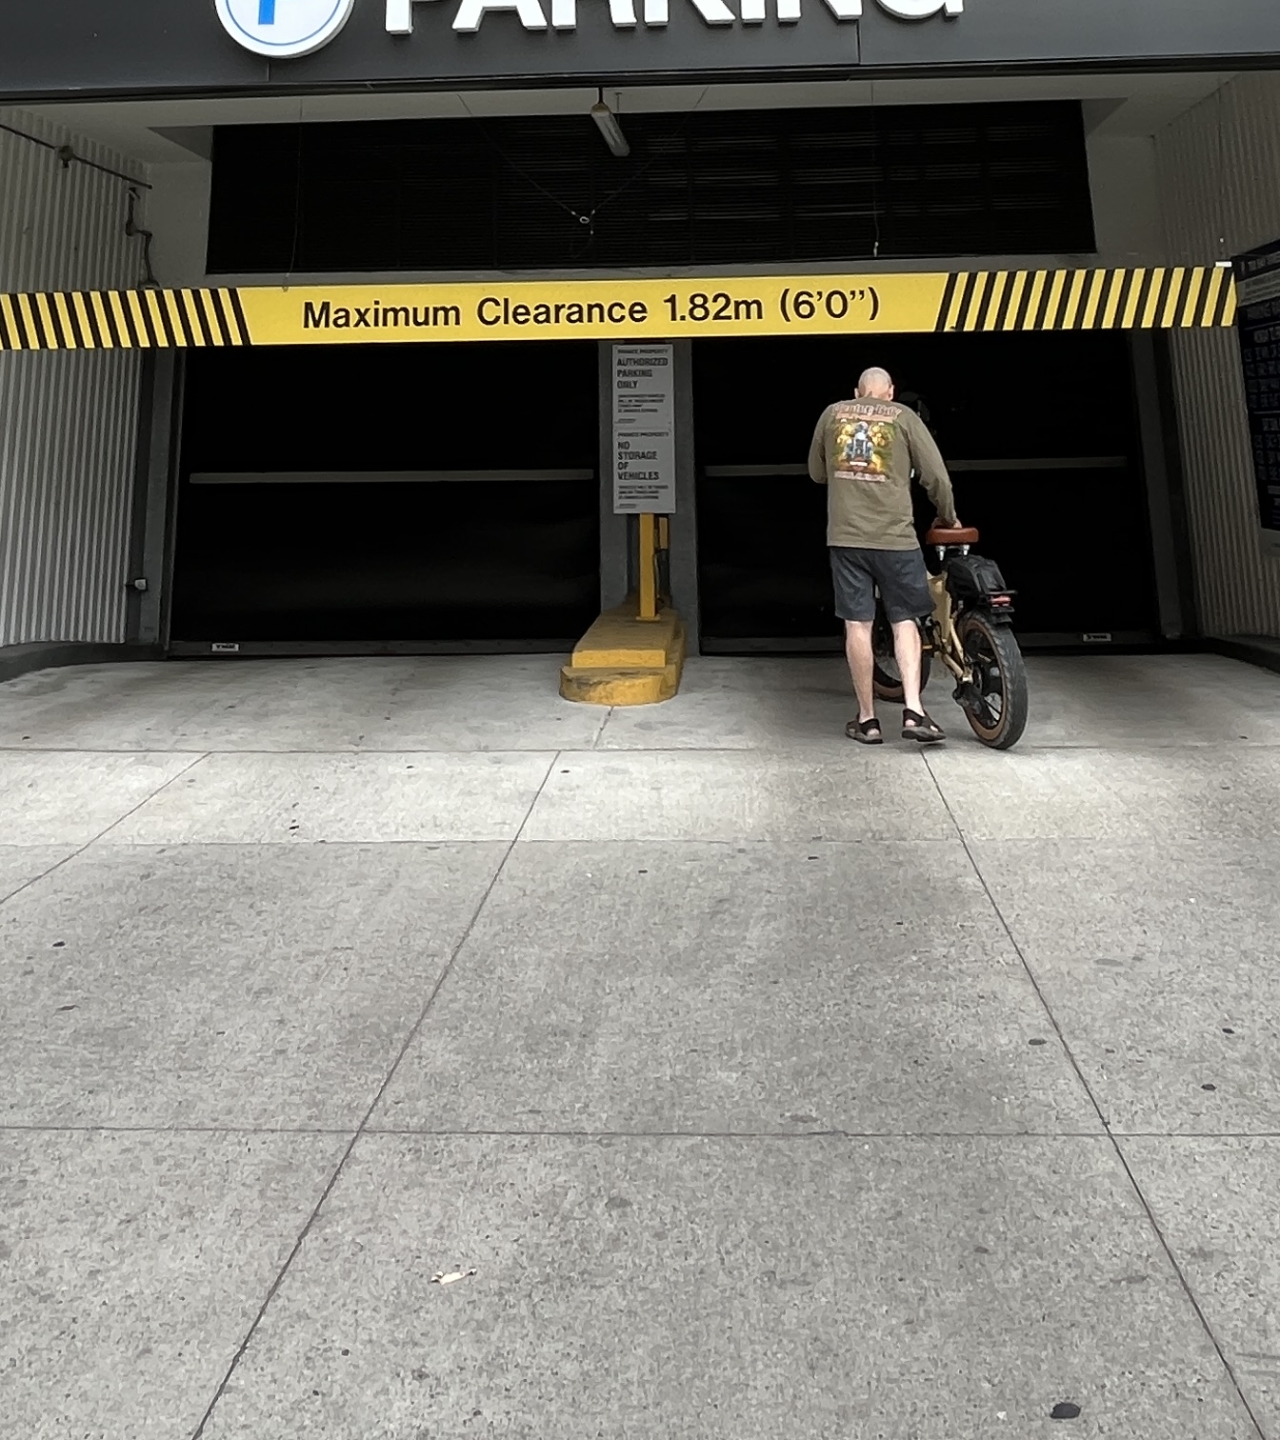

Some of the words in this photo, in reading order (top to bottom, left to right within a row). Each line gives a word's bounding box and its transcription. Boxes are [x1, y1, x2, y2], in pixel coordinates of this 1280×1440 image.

[302, 300, 461, 329] Maximum
[476, 297, 648, 326] Clearance
[663, 292, 763, 322] 1.82m
[617, 357, 668, 367] AUTHORIZED
[617, 369, 653, 378] PARKING
[617, 441, 630, 450] NO
[617, 451, 658, 461] STORAGE
[617, 461, 629, 471] OF
[617, 471, 660, 481] VEHICLES
